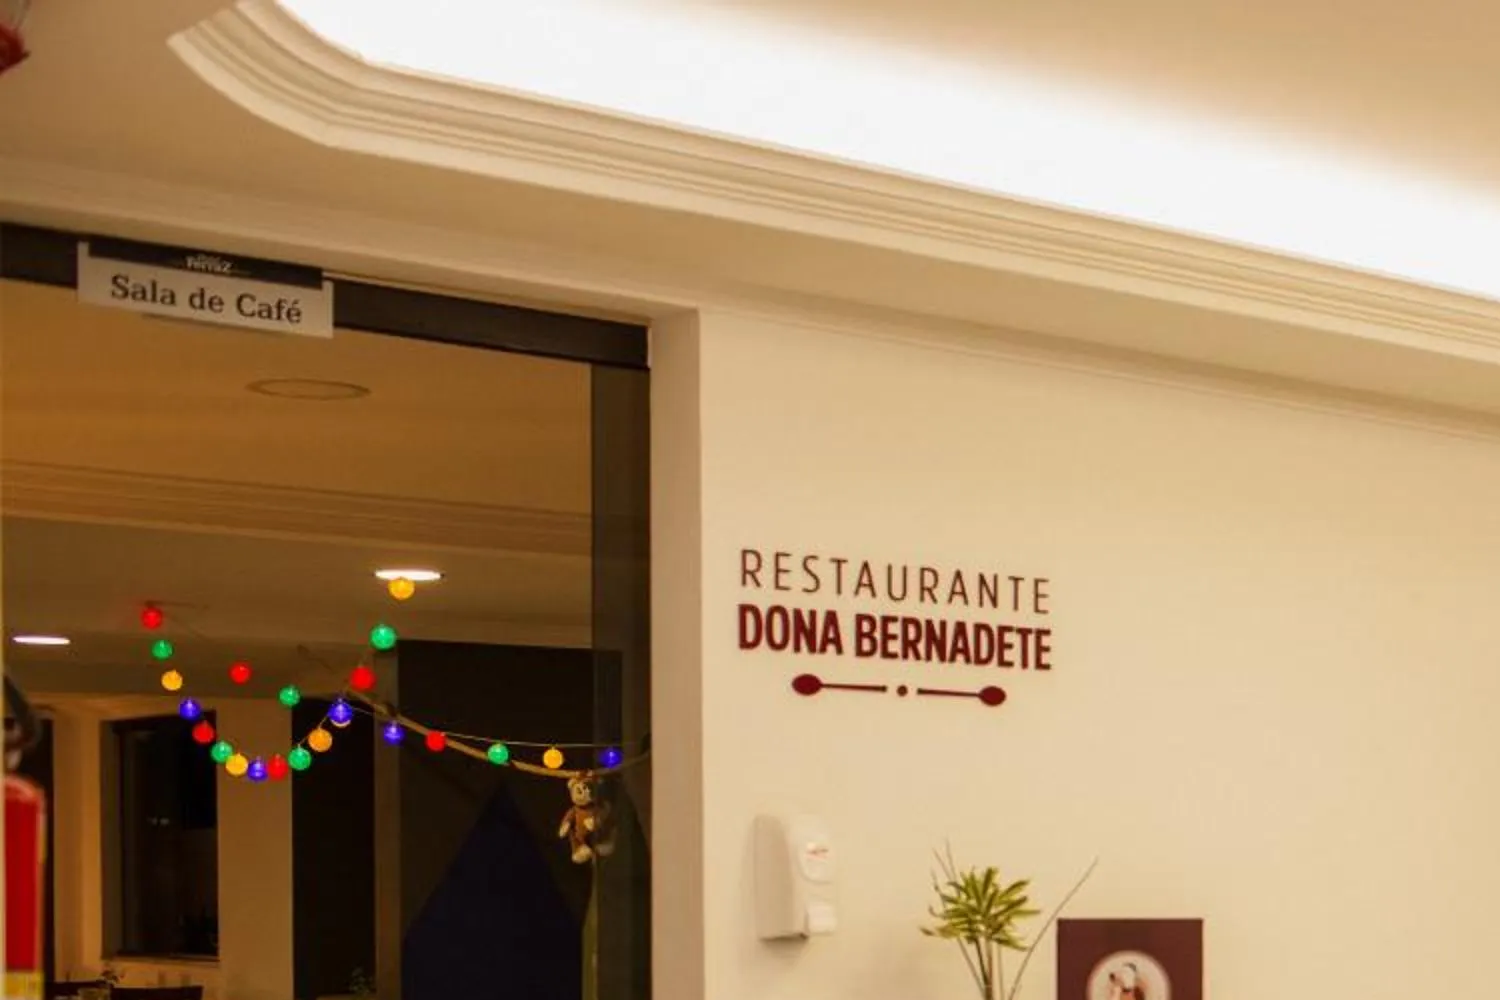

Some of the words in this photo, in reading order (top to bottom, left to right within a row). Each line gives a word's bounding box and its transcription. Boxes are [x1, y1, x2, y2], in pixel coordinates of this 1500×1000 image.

[111, 274, 176, 307] Sala
[189, 288, 224, 313] de
[236, 293, 302, 324] Café
[740, 549, 1051, 615] RESTAURANTE
[737, 603, 844, 656] DONA
[855, 613, 1052, 671] BERNADETE
